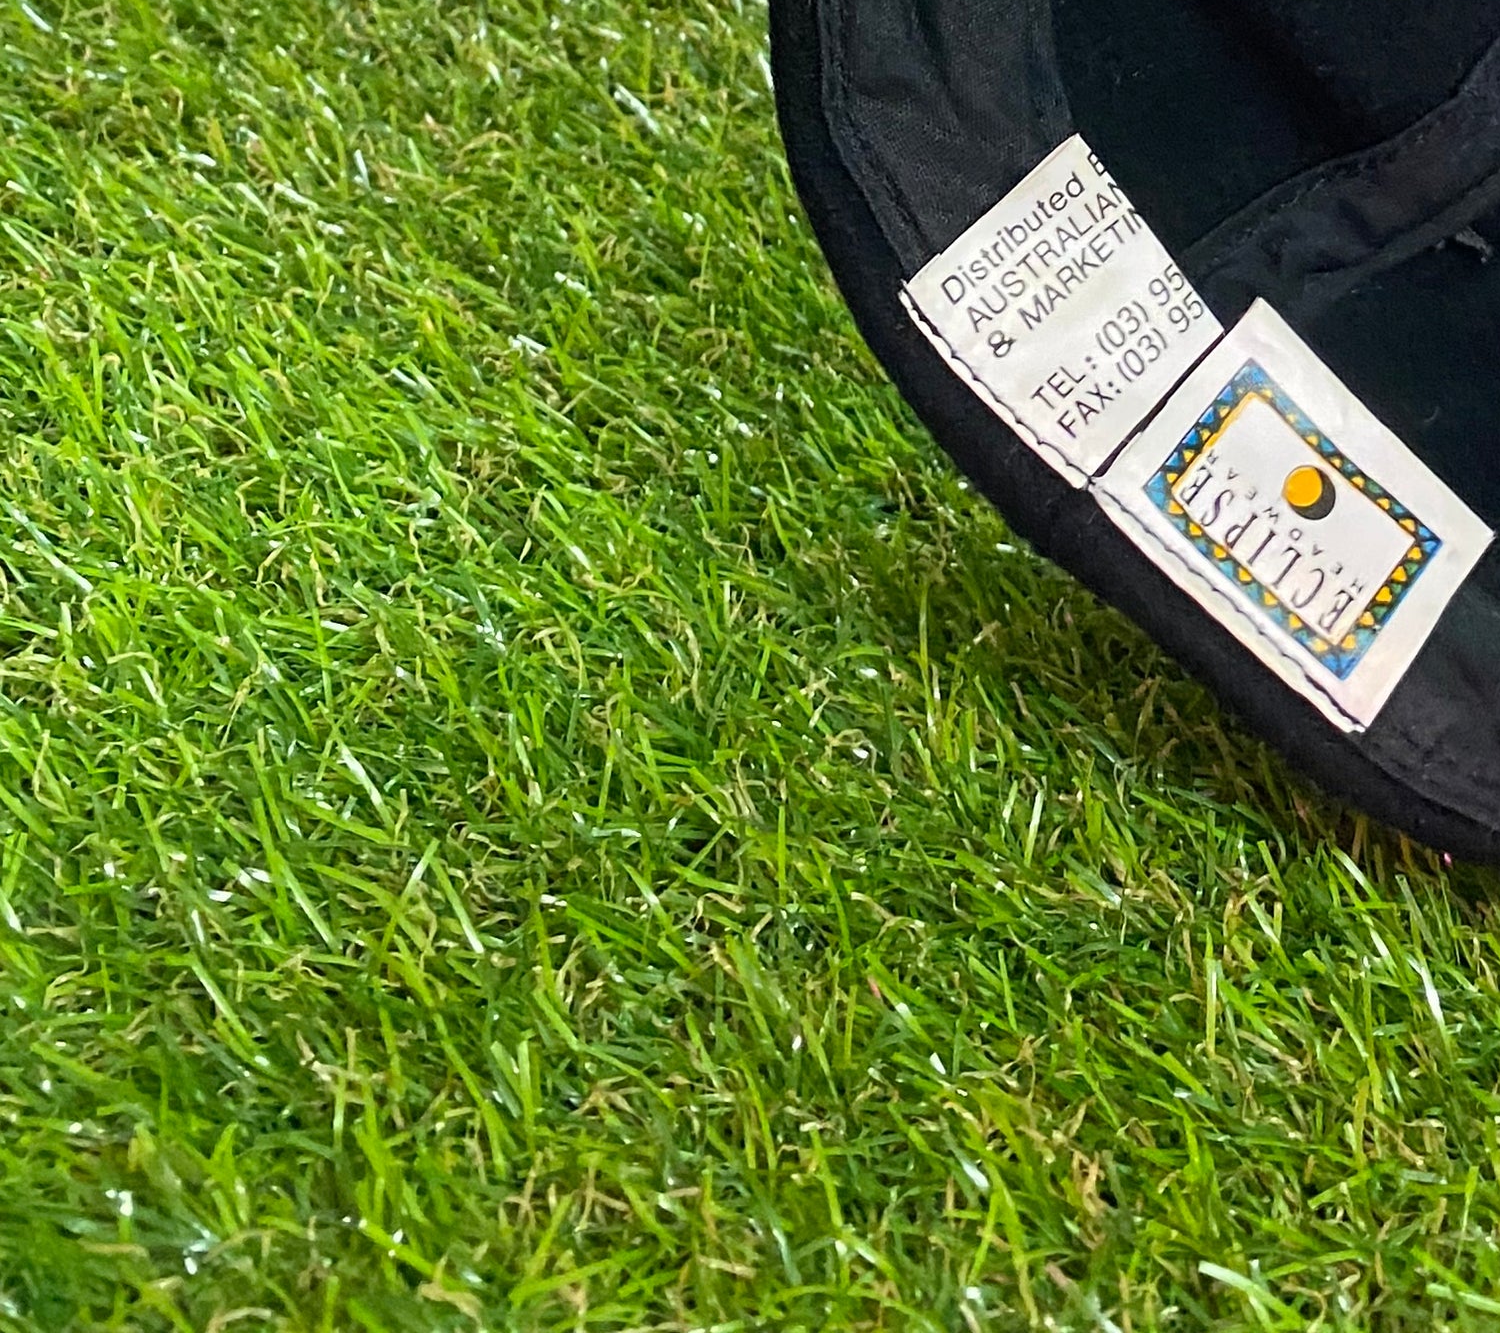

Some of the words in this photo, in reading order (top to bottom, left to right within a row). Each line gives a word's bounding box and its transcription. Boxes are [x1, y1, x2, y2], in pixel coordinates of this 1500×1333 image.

[941, 171, 1085, 305] Distributed
[988, 329, 1017, 358] &
[1057, 380, 1122, 439] FAX:
[1115, 327, 1168, 382] (03)
[1167, 290, 1205, 334] 95
[1095, 300, 1150, 355] (03)
[1148, 263, 1184, 307] 95
[1179, 465, 1354, 633] ECLIPSE
[1206, 449, 1364, 595] HEADWEAR
